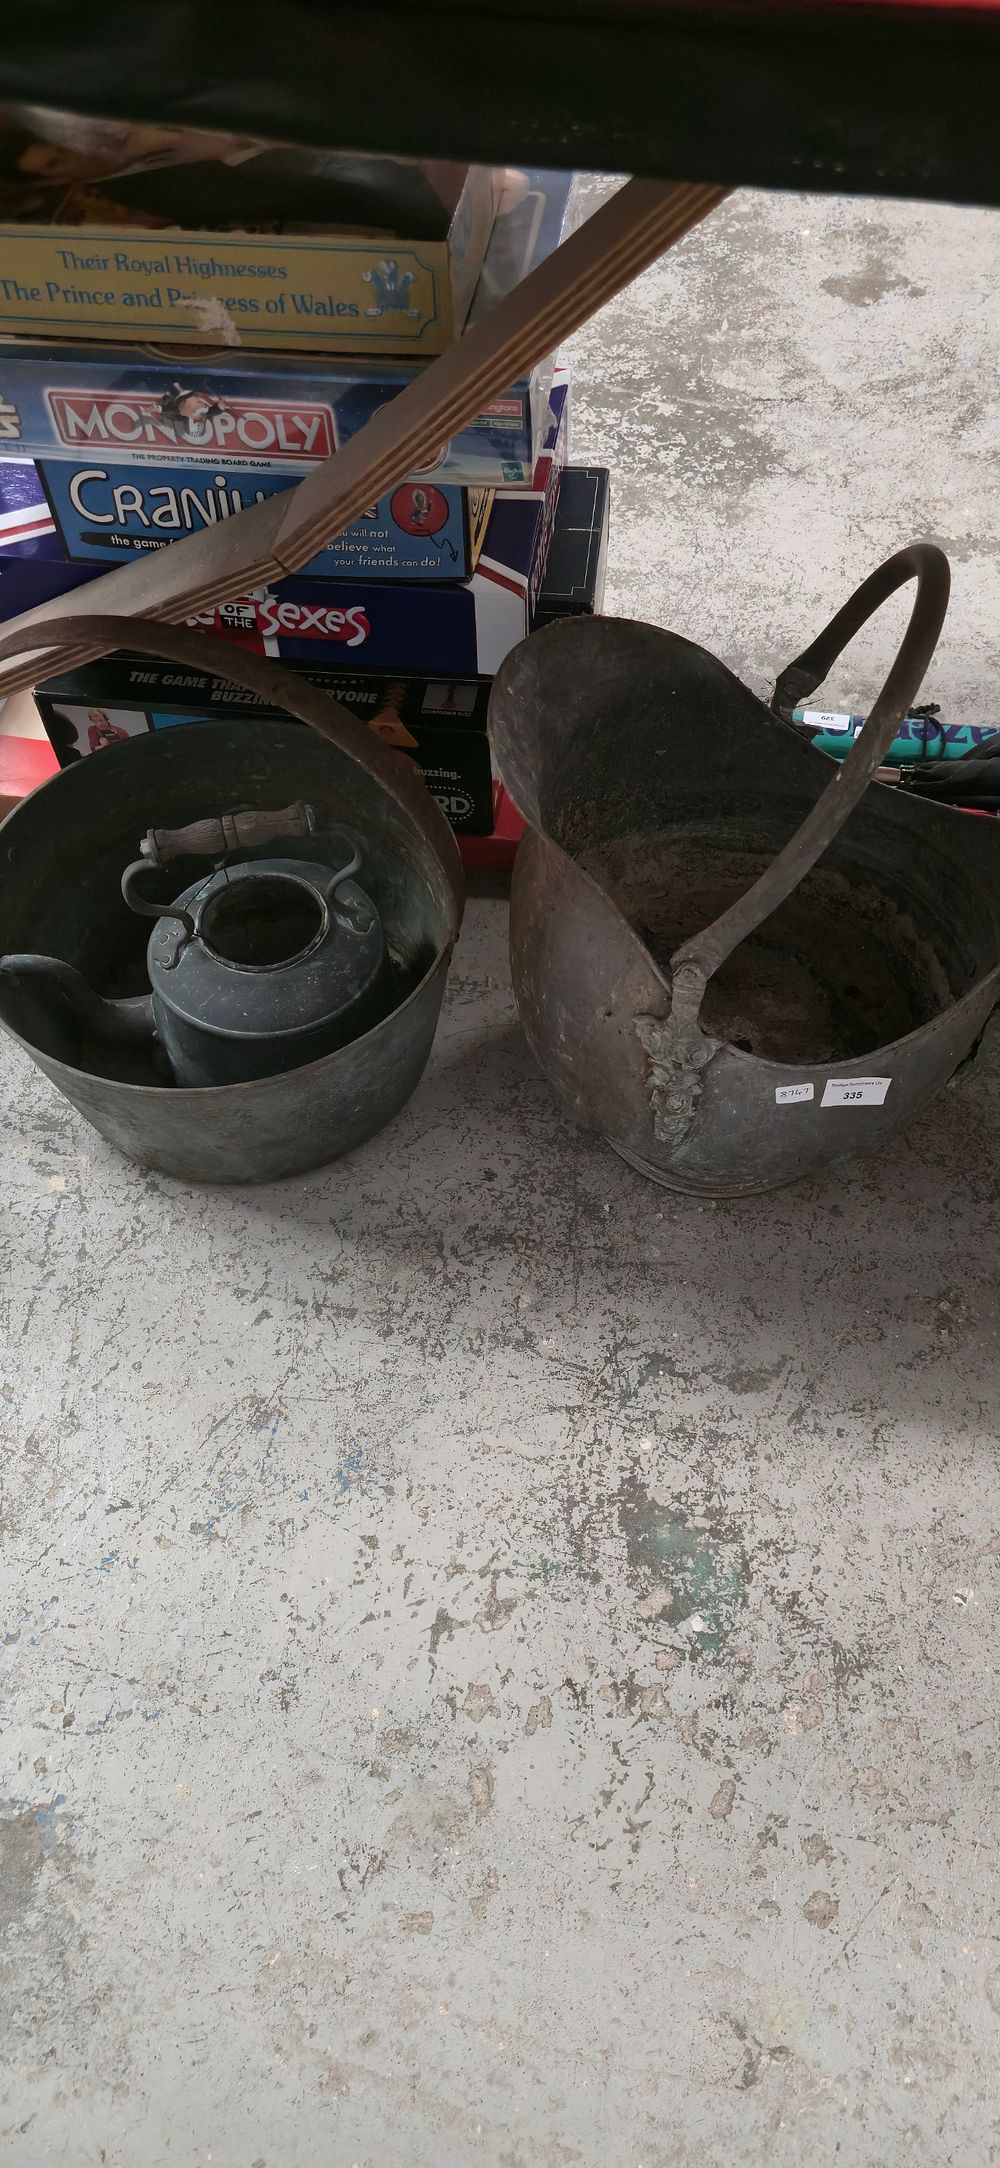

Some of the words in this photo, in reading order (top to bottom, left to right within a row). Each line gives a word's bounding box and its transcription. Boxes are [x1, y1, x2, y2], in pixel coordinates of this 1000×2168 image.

[56, 250, 108, 271] Their
[114, 253, 170, 276] Royal
[175, 255, 288, 279] Highnesses
[1, 279, 40, 301] The
[45, 281, 115, 305] Prince
[122, 288, 162, 308] and
[265, 293, 285, 314] of
[291, 293, 360, 317] Wales
[63, 402, 320, 451] MONOPOLY
[147, 455, 185, 463] PROPERTY
[186, 457, 220, 465] TRADING
[221, 459, 248, 467] BOARD
[249, 460, 272, 468] GAME
[351, 529, 367, 538] will
[370, 530, 388, 538] not
[111, 535, 130, 546] the
[133, 537, 167, 549] game
[372, 545, 396, 553] what
[334, 559, 355, 567] your
[358, 556, 399, 567] friends
[421, 556, 441, 567] do!
[223, 605, 249, 616] OF
[223, 616, 253, 628] THE
[129, 671, 157, 684] THE
[162, 674, 208, 688] GAME
[211, 678, 246, 692] THA
[210, 690, 275, 705] BUZZIN
[843, 1091, 863, 1100] 335
